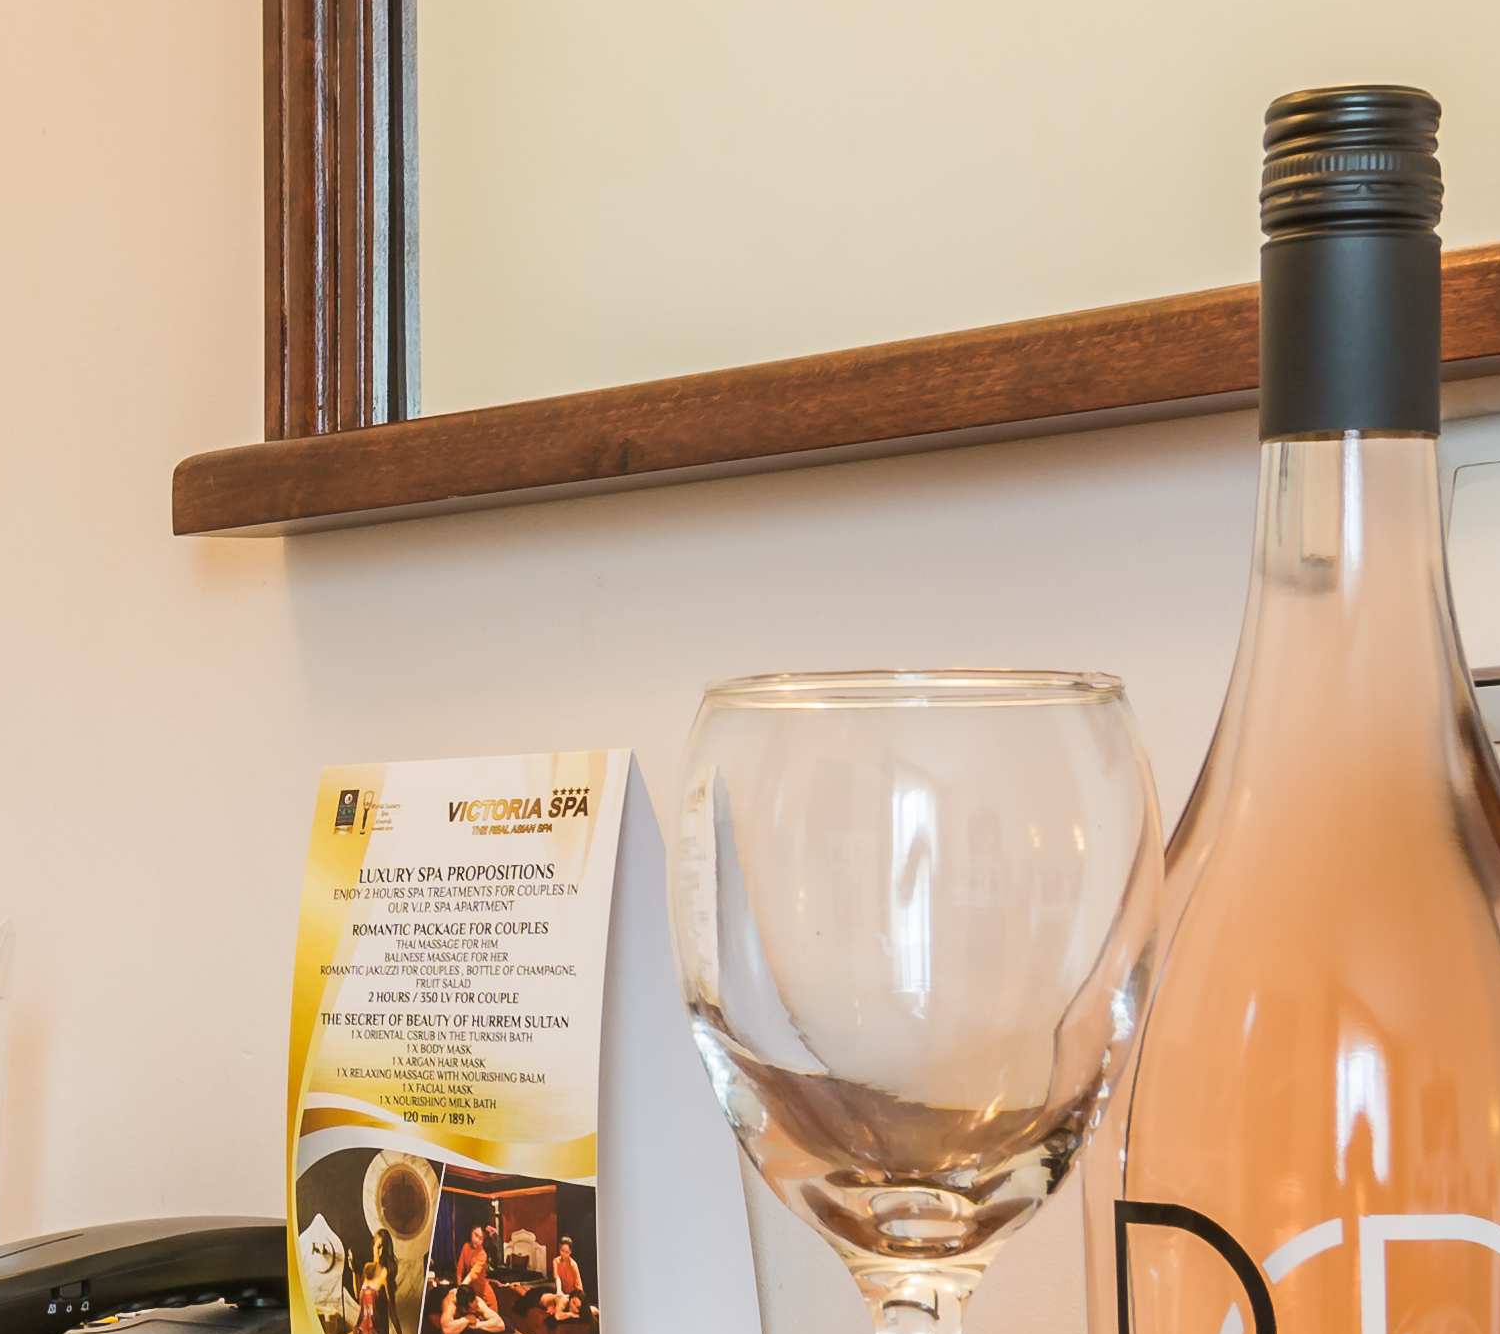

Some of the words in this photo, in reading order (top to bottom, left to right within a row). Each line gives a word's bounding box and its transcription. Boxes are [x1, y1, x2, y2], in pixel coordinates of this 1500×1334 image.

[448, 797, 542, 822] VICTORIA
[548, 796, 589, 818] SPA
[537, 823, 553, 833] SPA
[358, 867, 414, 884] LUXURY
[417, 866, 443, 882] SPA
[447, 863, 555, 882] PROPOSITIONS
[333, 888, 363, 899] ENJOY
[372, 887, 406, 899] HOURS
[406, 887, 425, 898] SPA
[427, 885, 493, 898] TREATMENTS
[494, 885, 515, 897] FOR
[516, 884, 565, 896] COUPLES
[567, 883, 579, 895] IN
[387, 901, 409, 913] OUR
[433, 901, 452, 913] SPA
[453, 900, 514, 913] APARTMENT
[352, 923, 411, 936] ROMANTIC
[413, 922, 467, 935] PACKAGE
[469, 922, 492, 935] FOR
[494, 921, 549, 935] COUPLES
[396, 939, 416, 949] THAI
[418, 939, 460, 949] MASSAGE
[461, 939, 479, 949] FOR
[481, 939, 499, 949] HIM
[384, 952, 426, 962] BALINESE
[426, 952, 469, 962] MASSAGE
[470, 952, 489, 962] FOR
[490, 952, 509, 962] HER
[319, 965, 364, 975] ROMANTIC
[365, 966, 399, 976] JAKUZZI
[401, 966, 419, 976] FOR
[419, 966, 460, 976] COUPLES
[466, 966, 501, 976] BOTTLE
[502, 966, 514, 976] OF
[415, 979, 440, 989] FRUIT
[441, 979, 472, 989] SALAD
[376, 992, 411, 1003] HOURS
[420, 992, 439, 1003] 350
[440, 992, 452, 1003] LV
[454, 992, 475, 1003] FOR
[477, 992, 519, 1004] COUPLE
[320, 1013, 342, 1025] THE
[344, 1013, 385, 1026] SECRET
[388, 1014, 404, 1026] OF
[406, 1014, 451, 1027] BEAUTY
[453, 1015, 469, 1027] OF
[471, 1015, 522, 1028] HURREM
[524, 1015, 569, 1028] SULTAN
[363, 1030, 405, 1040] ORIENTAL
[437, 1031, 447, 1041] IN
[450, 1032, 467, 1041] THE
[469, 1032, 507, 1042] TURKISH
[509, 1033, 533, 1042] BATH
[420, 1044, 445, 1054] BODY
[446, 1045, 473, 1055] MASK
[405, 1057, 436, 1067] ARGAN
[437, 1057, 459, 1067] HAIR
[460, 1058, 486, 1068] MASK
[349, 1069, 392, 1079] RELAXING
[393, 1070, 435, 1081] MASSAGE
[436, 1071, 460, 1081] WITH
[461, 1071, 518, 1083] NOURISHING
[519, 1073, 546, 1084] BALM
[415, 1083, 446, 1094] FACIAL
[447, 1084, 474, 1095] MASK
[392, 1096, 447, 1107] NOURISHING
[448, 1097, 472, 1108] MILK
[472, 1098, 497, 1109] BATH
[403, 1111, 418, 1123] 120
[421, 1113, 439, 1123] min
